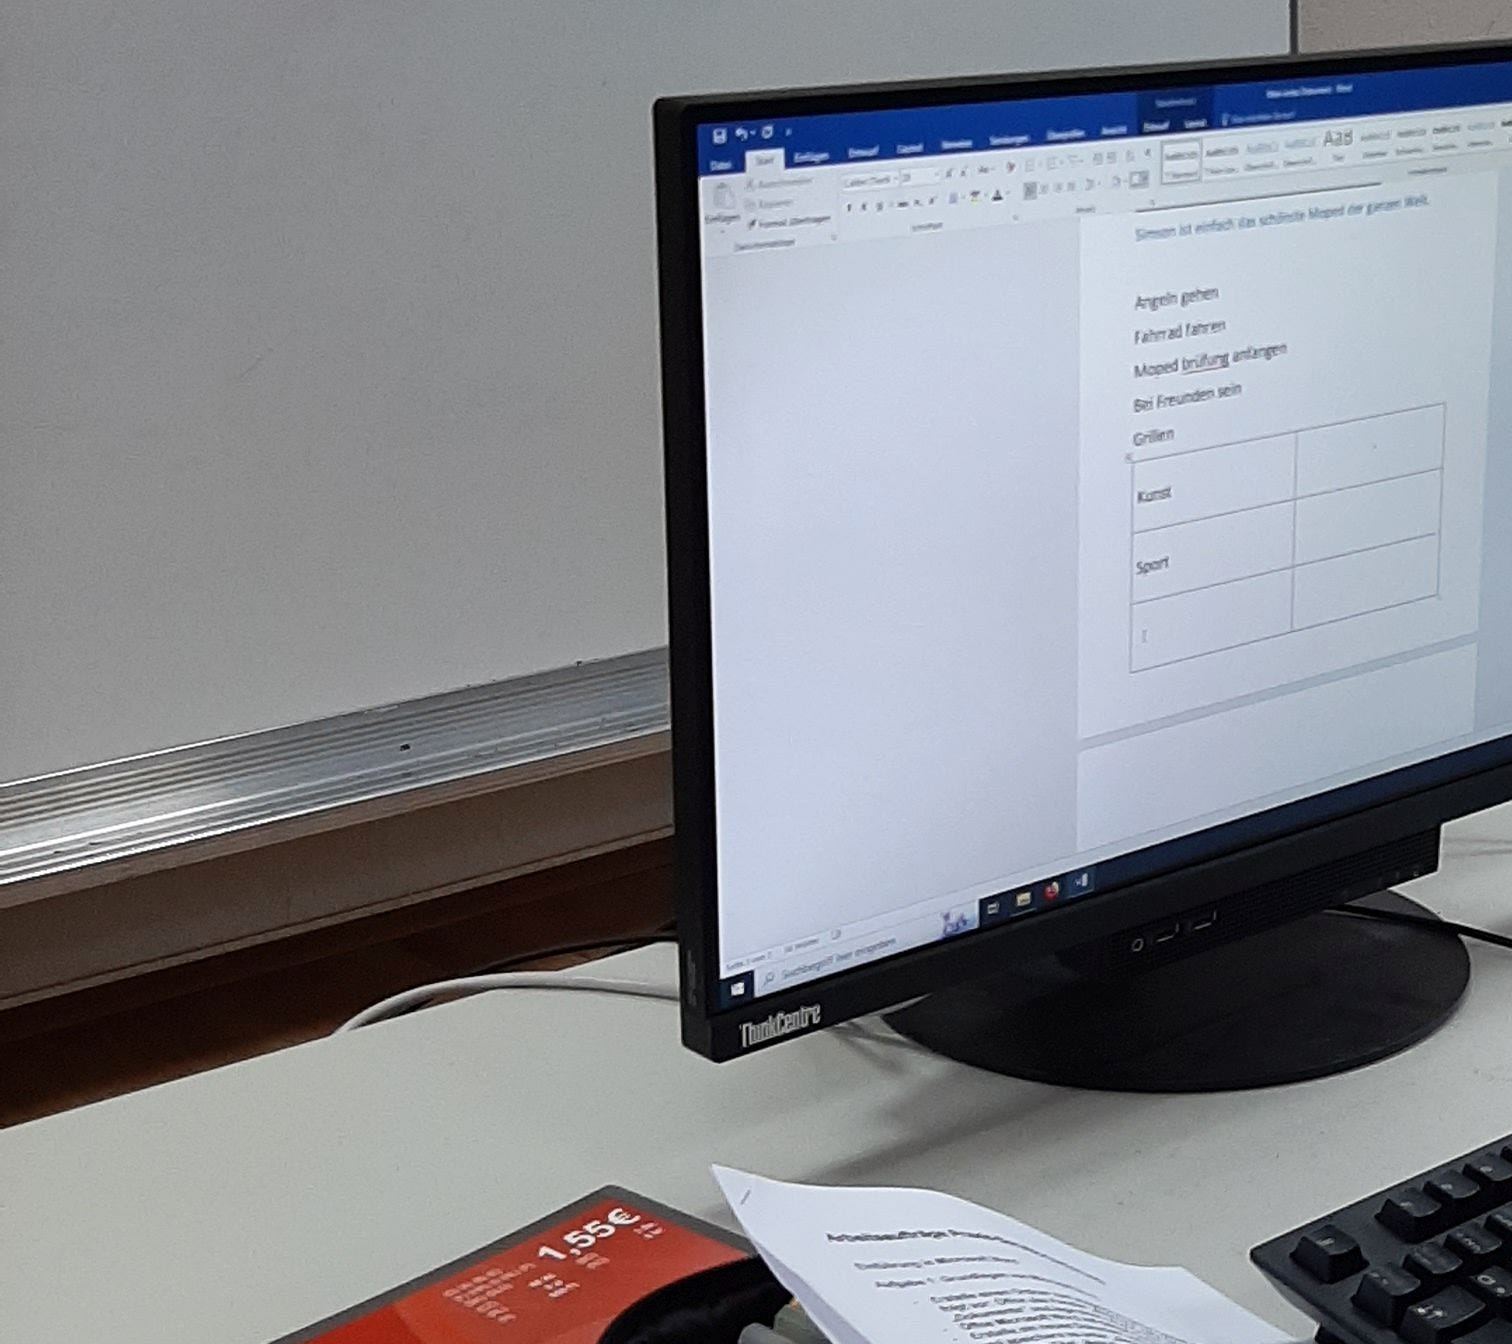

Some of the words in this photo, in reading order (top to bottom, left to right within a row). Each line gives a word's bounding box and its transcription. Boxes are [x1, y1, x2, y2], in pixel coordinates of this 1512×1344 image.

[1181, 286, 1219, 309] gehen
[1134, 324, 1182, 345] Fahrrad
[1186, 318, 1226, 339] fahren
[1133, 358, 1179, 379] Moped
[1233, 341, 1288, 366] anfangen
[1133, 396, 1153, 413] Bei
[1156, 387, 1215, 411] Freunden
[1217, 382, 1242, 400] sein
[1137, 486, 1172, 504] Kunst
[1136, 556, 1170, 576] Sport
[739, 1003, 822, 1047] ThinkCentre
[537, 1206, 642, 1261] 1,55€
